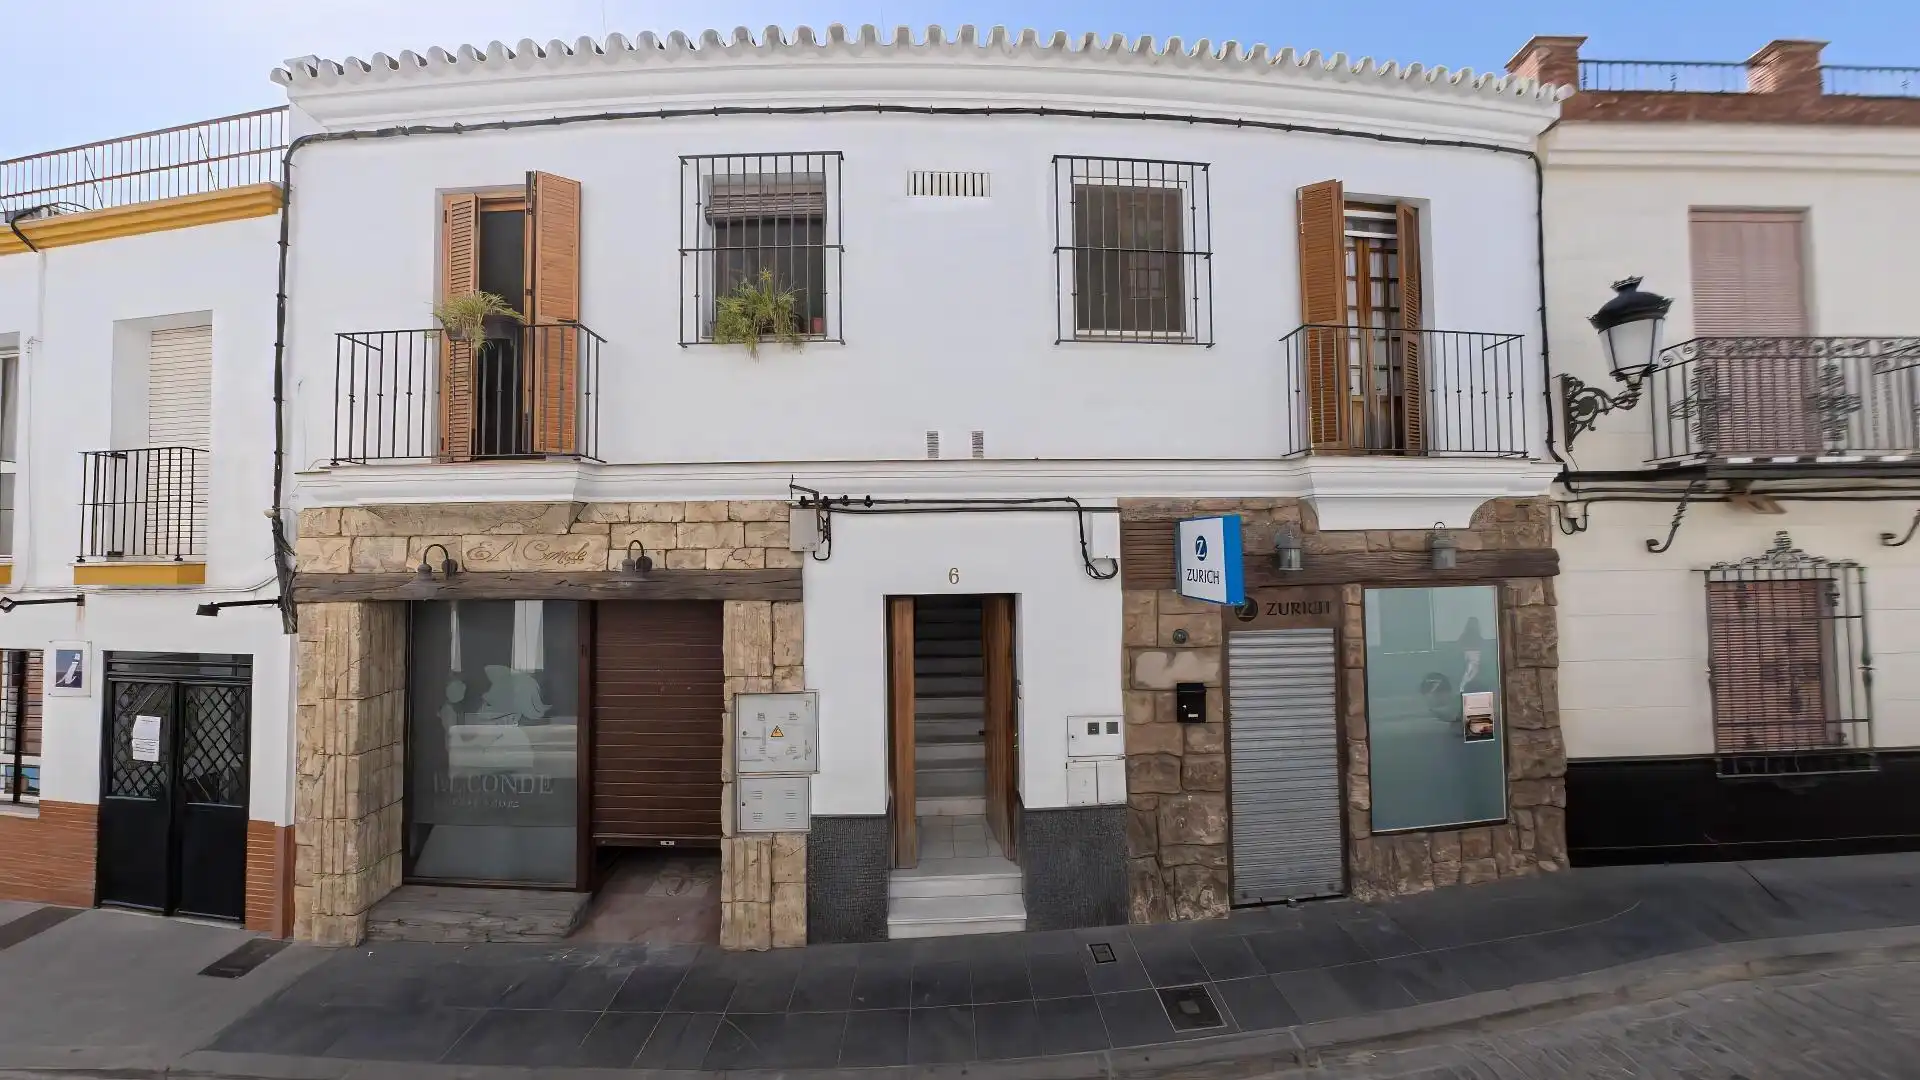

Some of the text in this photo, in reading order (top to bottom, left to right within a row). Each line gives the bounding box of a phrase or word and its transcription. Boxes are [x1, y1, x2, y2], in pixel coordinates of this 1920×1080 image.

[948, 567, 960, 585] 6
[1187, 568, 1220, 584] ZURICH
[1265, 600, 1330, 616] ZURICH
[467, 773, 554, 795] CONDE
